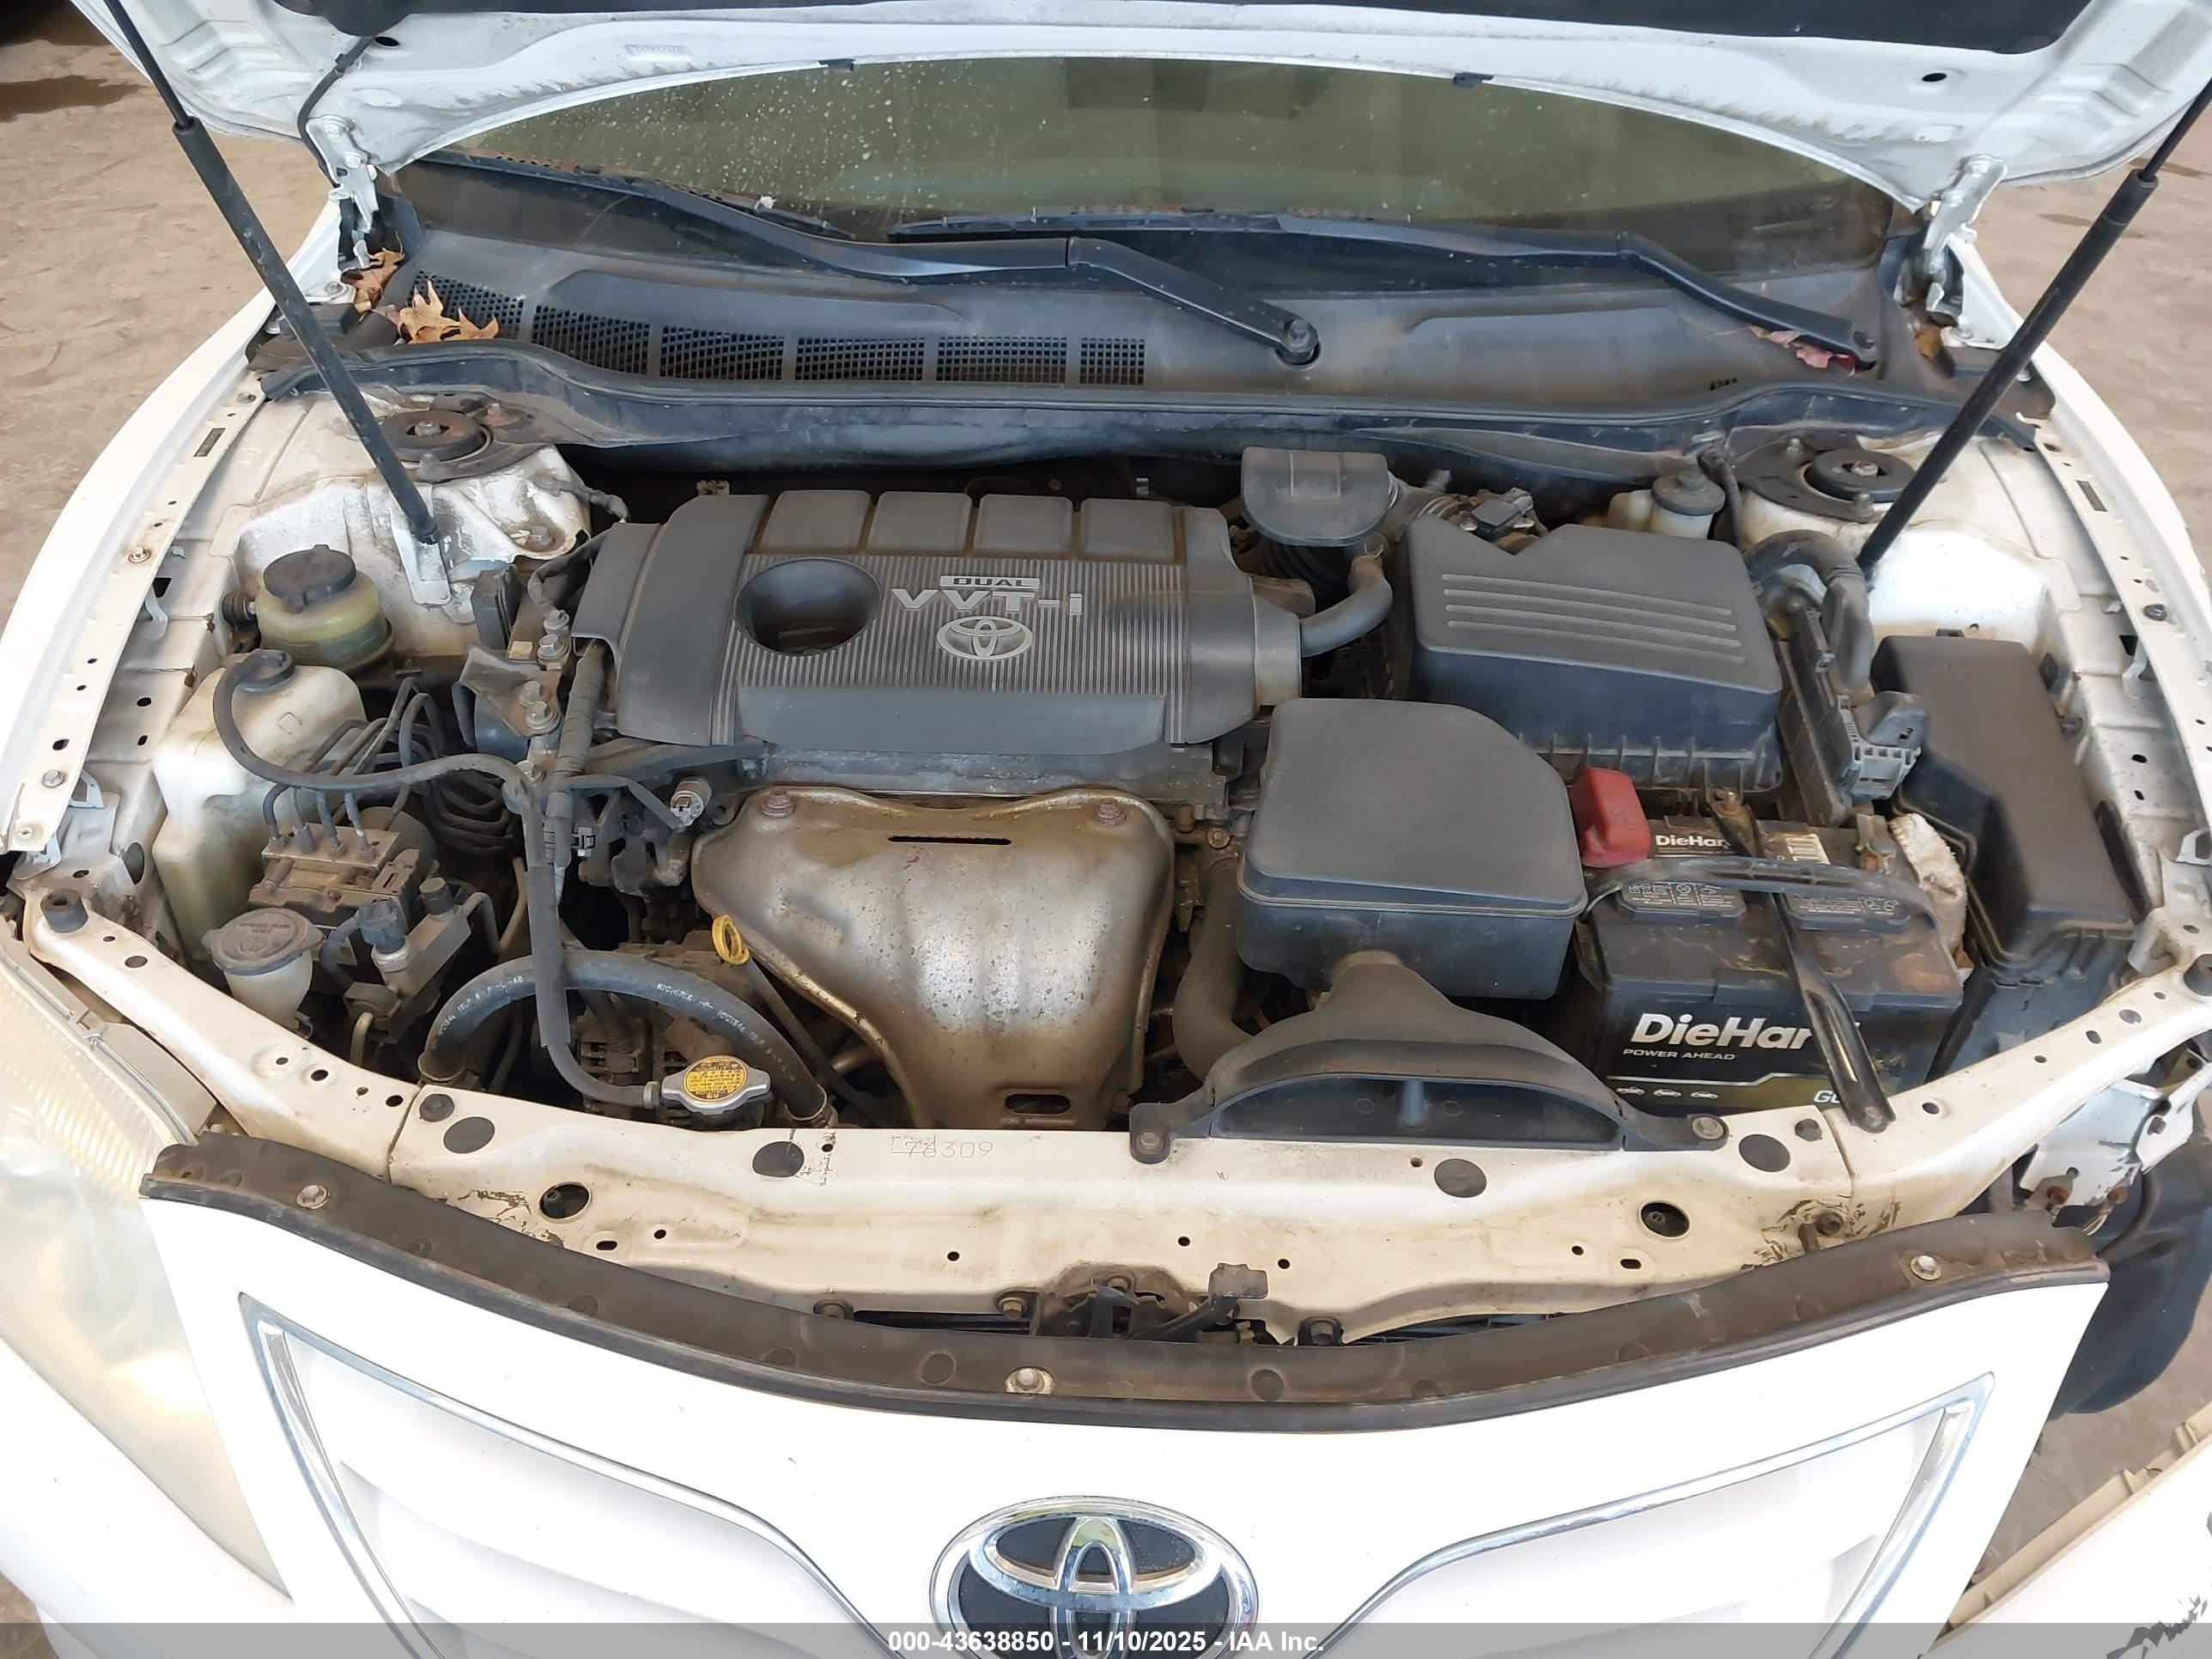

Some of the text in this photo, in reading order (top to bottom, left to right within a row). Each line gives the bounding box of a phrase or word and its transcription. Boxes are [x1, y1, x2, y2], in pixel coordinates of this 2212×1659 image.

[953, 577, 1030, 587] DUAL
[890, 588, 1084, 616] VVT-i
[1656, 835, 1731, 849] DieHar
[1631, 1012, 1814, 1050] DieHar
[1623, 1048, 1736, 1060] POWER AHEAD
[905, 1140, 994, 1158] 76309
